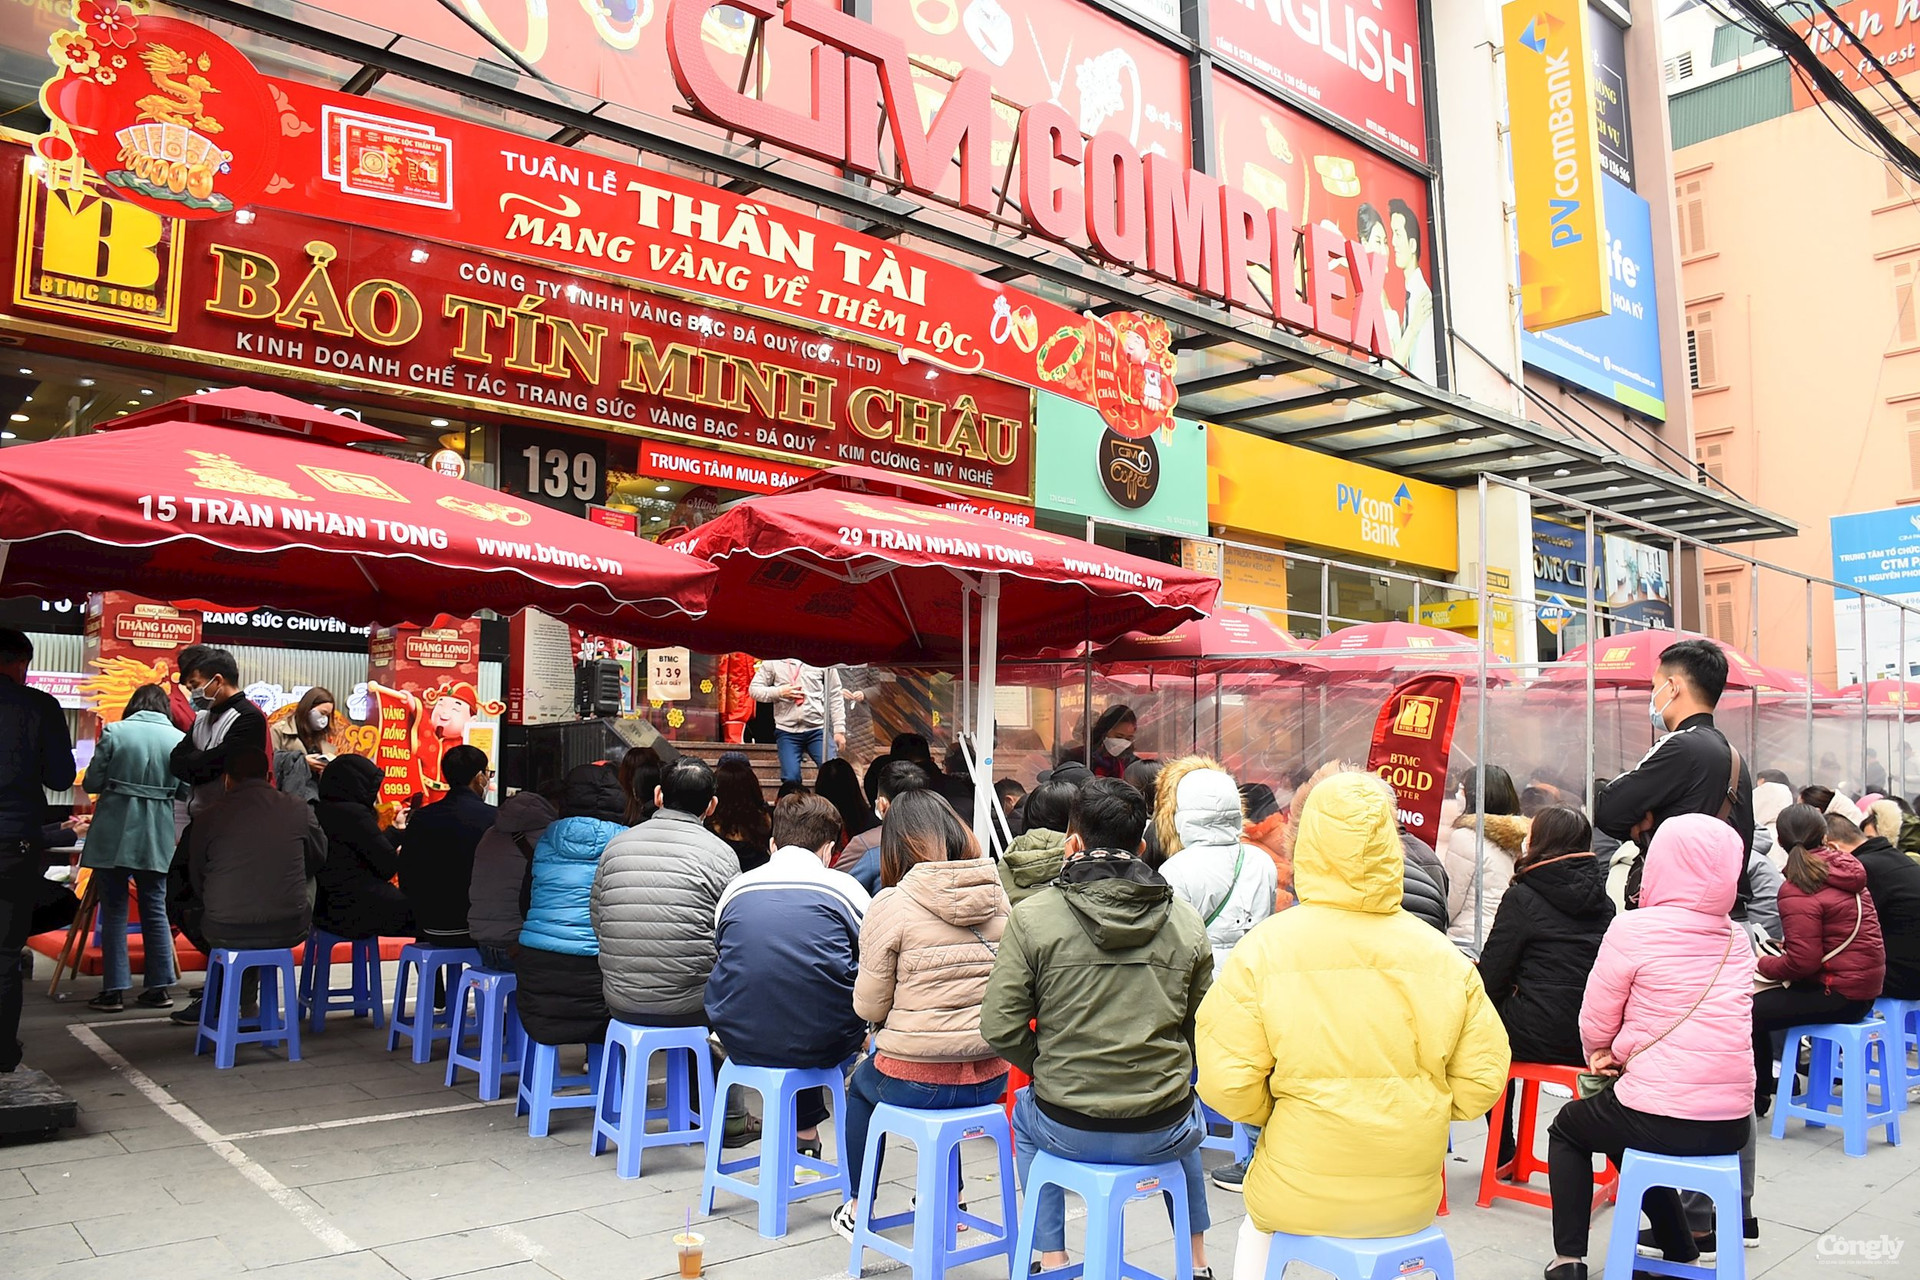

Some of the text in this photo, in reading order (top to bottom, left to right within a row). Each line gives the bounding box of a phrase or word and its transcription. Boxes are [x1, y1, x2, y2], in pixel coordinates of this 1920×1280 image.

[500, 150, 617, 197] TUẦN LỄ
[1020, 101, 1393, 358] COMPLEX
[625, 181, 927, 306] THẦN TÀI
[40, 276, 158, 312] BTMC 1989
[505, 212, 973, 357] MANG VÀNG VỀ THÊM LỘC
[1613, 293, 1631, 313] HOA
[459, 262, 526, 292] CÔNG
[535, 279, 562, 299] TY
[567, 284, 624, 315] TNHH
[629, 301, 683, 328] VÀNG
[688, 314, 726, 338] BẠC
[733, 321, 756, 345] ĐÁ
[763, 333, 797, 355] QUÝ
[846, 353, 882, 375] LTD)
[206, 240, 1022, 465] BẢO TÍN MINH CHÂU
[1098, 386, 1118, 399] CHÂU
[236, 332, 303, 360] KINH
[315, 344, 401, 380] DOANH
[410, 364, 455, 387] CHẾ
[465, 373, 507, 396] TÁC
[516, 383, 588, 411] TRANG
[596, 396, 637, 420] SỨC
[649, 408, 697, 431] VÀNG
[704, 416, 738, 439] BẠC
[756, 428, 777, 445] ĐÁ
[782, 432, 816, 452] QUÝ
[838, 444, 864, 461] KIM
[870, 449, 920, 473] CƯƠNG
[934, 461, 954, 477] MỸ
[958, 465, 994, 486] NGHỆ
[522, 445, 597, 501] 139
[1110, 461, 1151, 501] Coffee
[649, 452, 701, 475] TRUNG
[703, 458, 734, 480] TÂM
[735, 466, 768, 485] MUA
[770, 470, 799, 488] BÁN
[1002, 513, 1030, 528] PHÉP
[137, 494, 177, 522] 15
[476, 536, 623, 576] www.btmc.vn
[1361, 518, 1400, 548] Bank
[837, 526, 863, 547] 29
[1062, 556, 1163, 593] www.btmc.vn
[1840, 552, 1866, 562] TRUNG
[1866, 549, 1884, 559] TÂM
[1881, 556, 1920, 570] CTM P
[119, 619, 192, 634] THĂNG LONG
[252, 611, 284, 628] SỨC
[286, 617, 346, 634] CHUYÊN
[409, 641, 468, 654] THĂNG LONG
[658, 655, 679, 663] BTMC
[382, 705, 405, 721] VÀNG
[383, 723, 406, 740] RỒNG
[381, 746, 410, 760] THĂNG
[1390, 753, 1421, 768] BTMC
[384, 766, 407, 778] LONG
[1377, 765, 1433, 791] GOLD
[383, 783, 411, 795] 999.9
[1396, 790, 1420, 801] NTER
